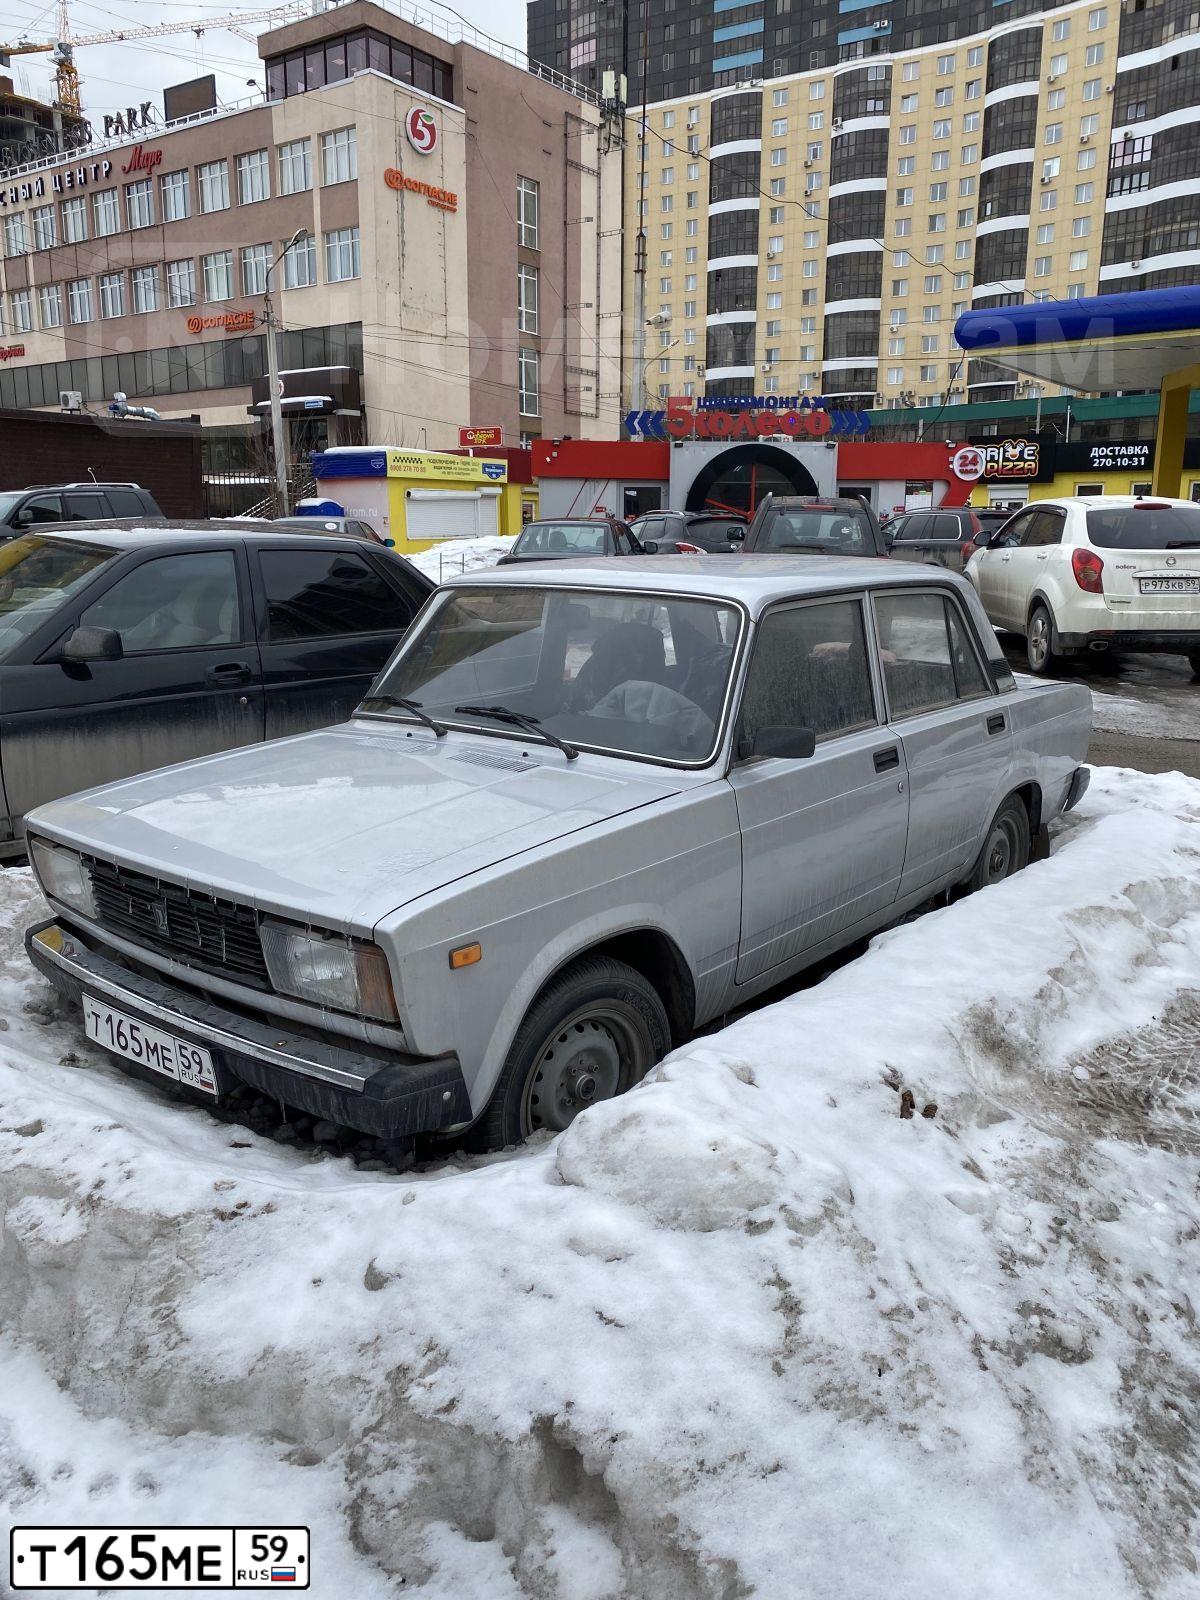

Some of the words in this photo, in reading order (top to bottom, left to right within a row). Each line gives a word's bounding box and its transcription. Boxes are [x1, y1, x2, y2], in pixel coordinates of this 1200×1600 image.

[102, 102, 155, 138] PARK
[52, 160, 113, 193] ЦЕНТР
[404, 178, 458, 206] СОГЛАСИЕ
[202, 310, 254, 328] СОГЛАСИЕ
[697, 396, 828, 409] ШИНОМОНТАЖ
[1090, 445, 1149, 458] ДОСТАВКА
[960, 454, 979, 468] 24
[986, 461, 1036, 475] PIZZA
[1092, 456, 1145, 467] 270-10-31
[1185, 579, 1196, 587] 59
[178, 1043, 203, 1075] 59
[181, 1069, 200, 1084] RUS
